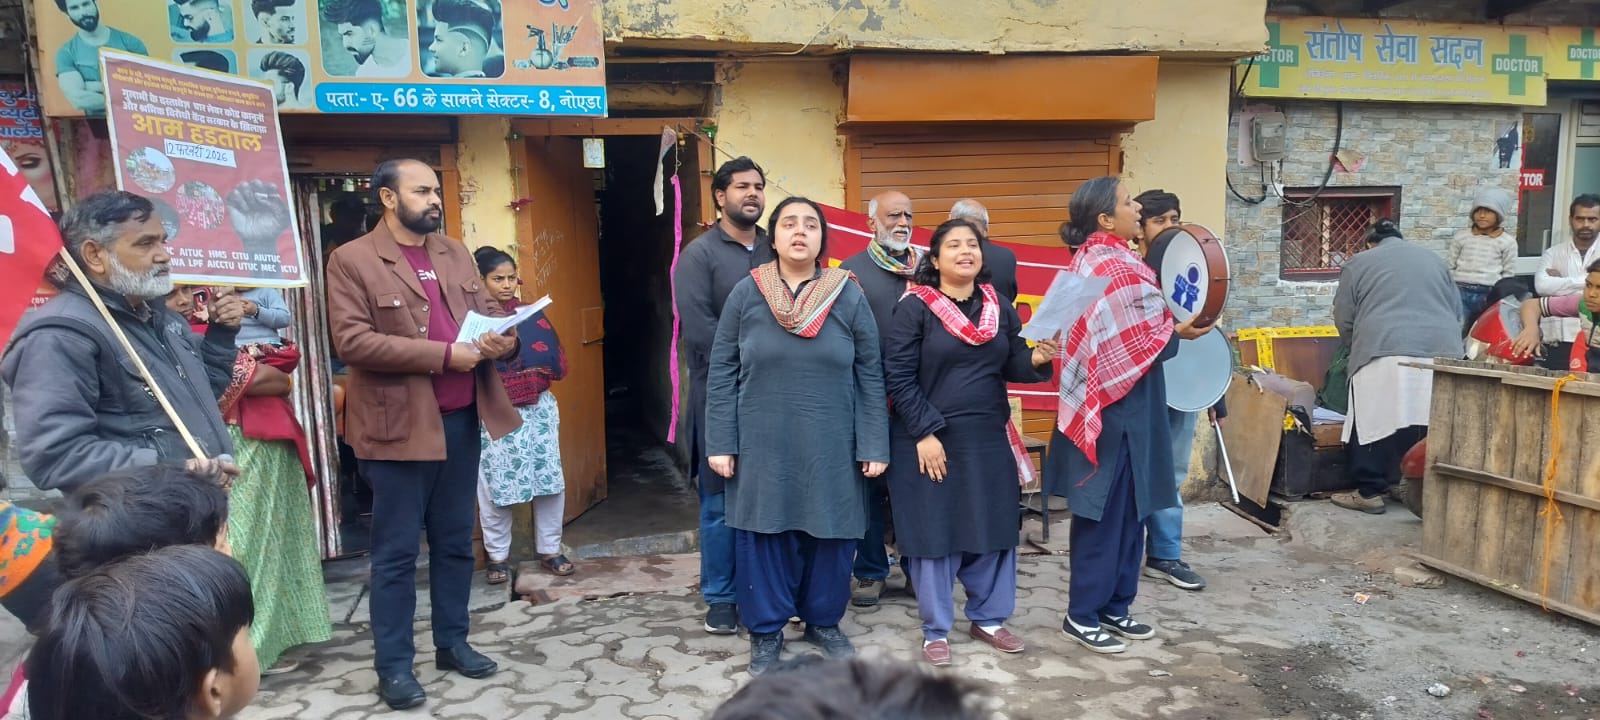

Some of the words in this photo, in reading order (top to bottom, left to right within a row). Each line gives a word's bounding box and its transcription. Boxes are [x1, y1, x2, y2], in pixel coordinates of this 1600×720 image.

[1304, 21, 1363, 62] संतोष
[1374, 23, 1418, 64] सेवा
[1429, 35, 1485, 70] सदन
[1570, 47, 1600, 60] DOCTO
[1495, 58, 1539, 73] DOCTOR
[393, 88, 418, 107] 66
[422, 90, 436, 108] के
[441, 90, 484, 109] सामने
[538, 89, 555, 112] 8,
[559, 90, 602, 112] नोएडा
[132, 112, 185, 139] आम
[206, 149, 228, 162] 2026
[180, 247, 204, 258] AITUC
[208, 249, 227, 259] HMS
[232, 252, 249, 261] CITU
[188, 258, 204, 268] LPF
[207, 260, 234, 270] AICCTU
[238, 261, 258, 271] UTUC
[261, 263, 277, 273] MEC
